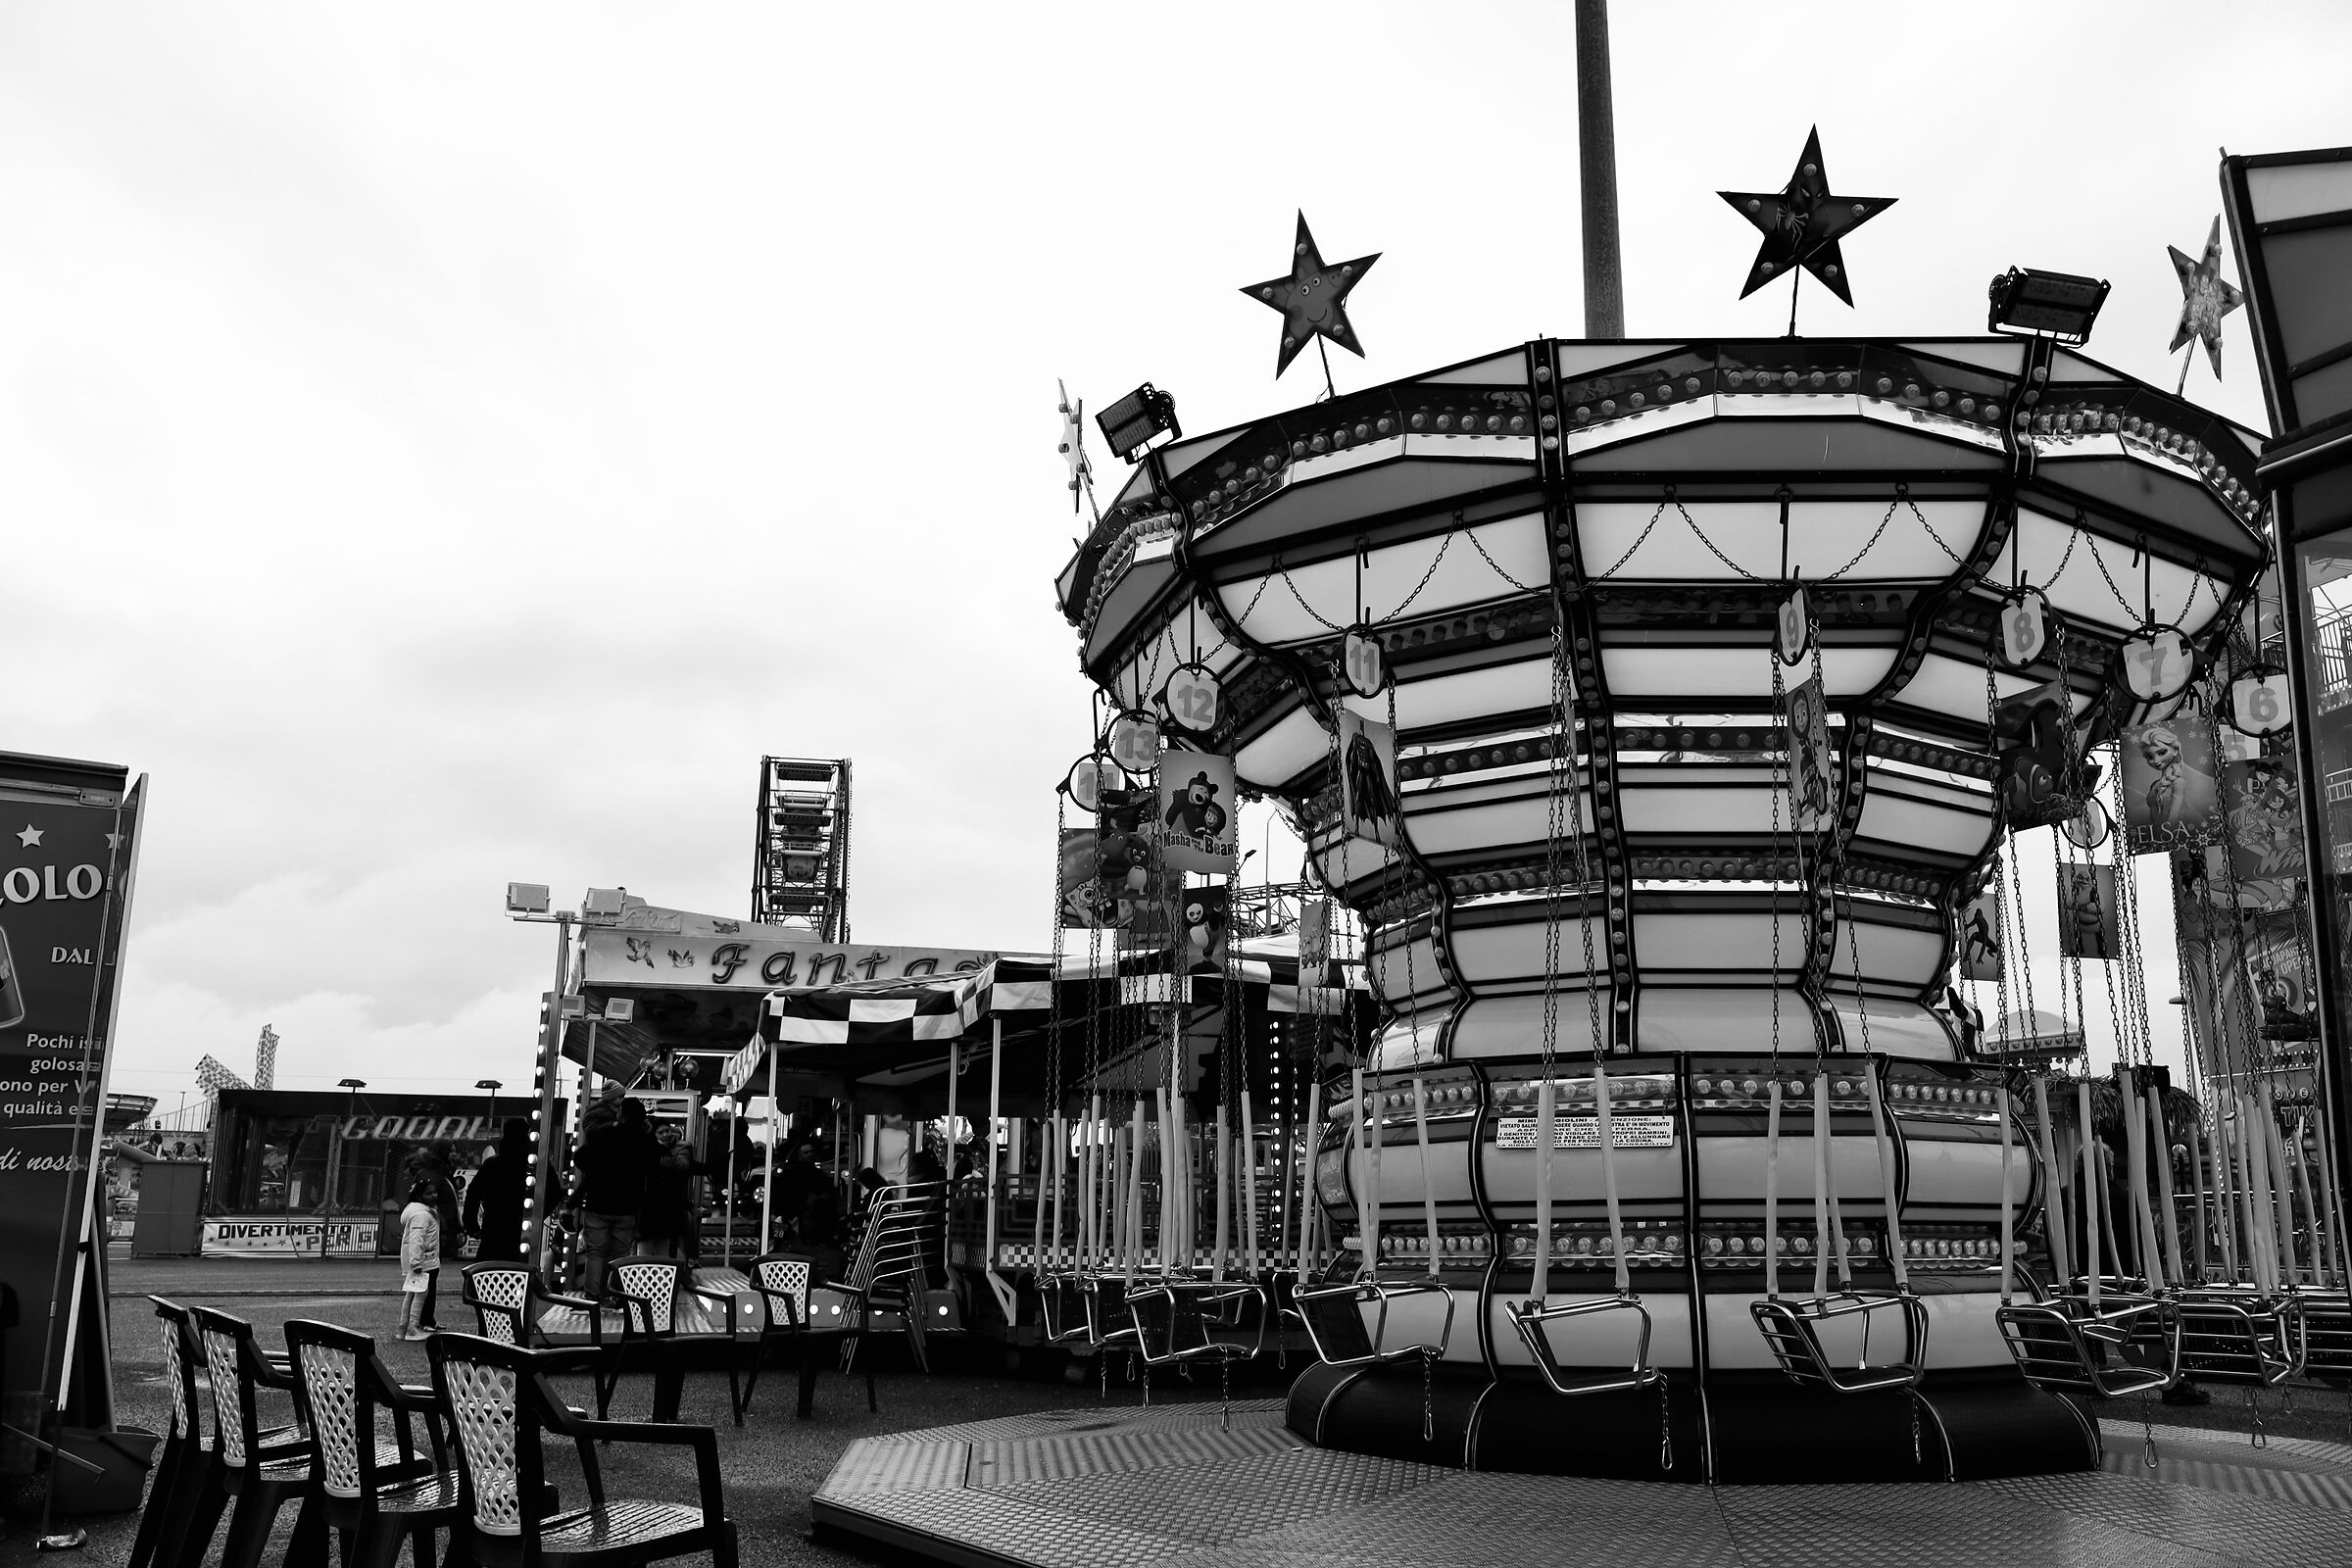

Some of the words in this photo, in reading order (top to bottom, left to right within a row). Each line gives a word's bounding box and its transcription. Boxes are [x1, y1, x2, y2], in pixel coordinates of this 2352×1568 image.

[1786, 609, 1799, 649] 9
[2013, 612, 2035, 653] 8
[1348, 644, 1378, 684] 11
[2139, 645, 2168, 687] 7
[1176, 684, 1213, 724] 12
[2249, 687, 2278, 722] 6
[1119, 728, 1155, 760] 13
[2224, 735, 2247, 761] 5
[1163, 830, 1191, 849] Masha
[2137, 820, 2191, 844] ELSA
[0, 864, 102, 904] OLO
[51, 947, 94, 964] DAL
[26, 1033, 74, 1049] Pochi
[38, 1081, 68, 1097] per
[3, 1101, 63, 1117] qualità
